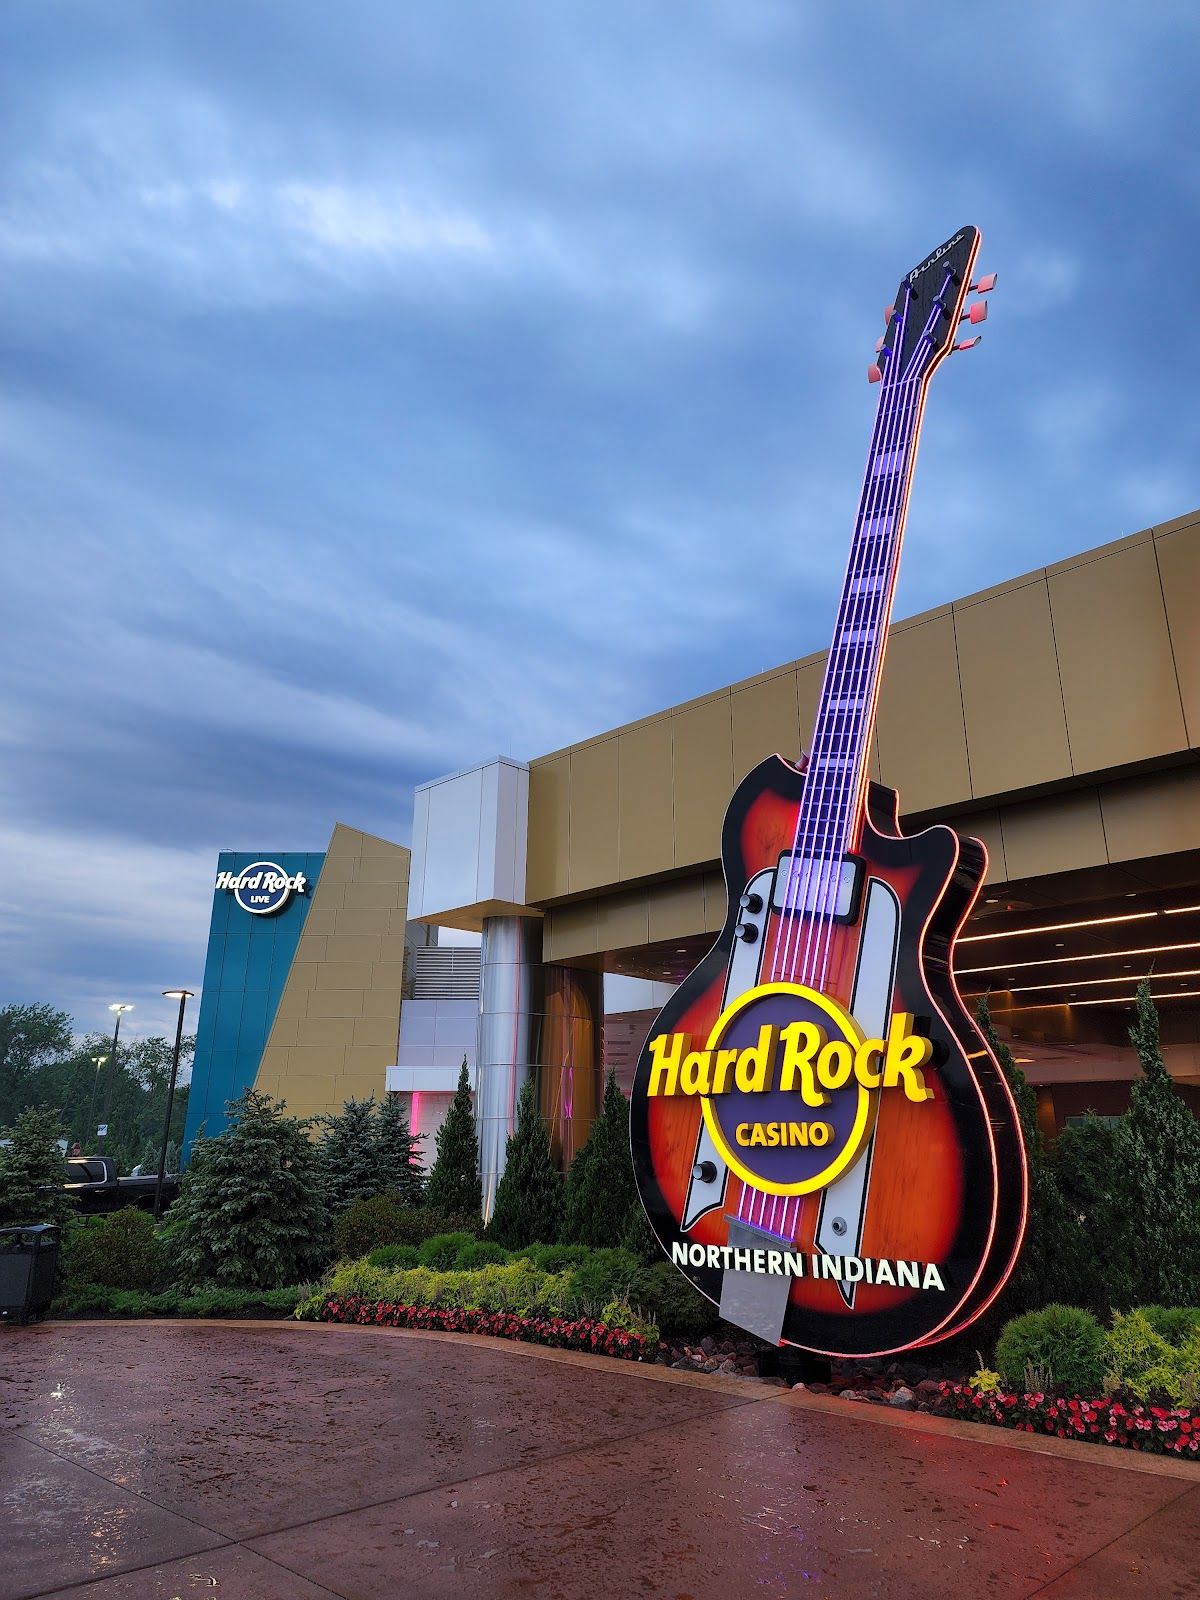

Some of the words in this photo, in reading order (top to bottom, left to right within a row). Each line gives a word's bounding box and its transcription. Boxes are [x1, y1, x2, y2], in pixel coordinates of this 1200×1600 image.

[215, 871, 263, 889] Hard
[262, 871, 306, 893] Rock
[250, 895, 270, 904] LIVE
[647, 1024, 778, 1097] Hard
[779, 1012, 934, 1107] Rock
[735, 1121, 834, 1147] CASINO
[672, 1241, 803, 1277] NORTHERN
[812, 1254, 946, 1291] INDIANA
